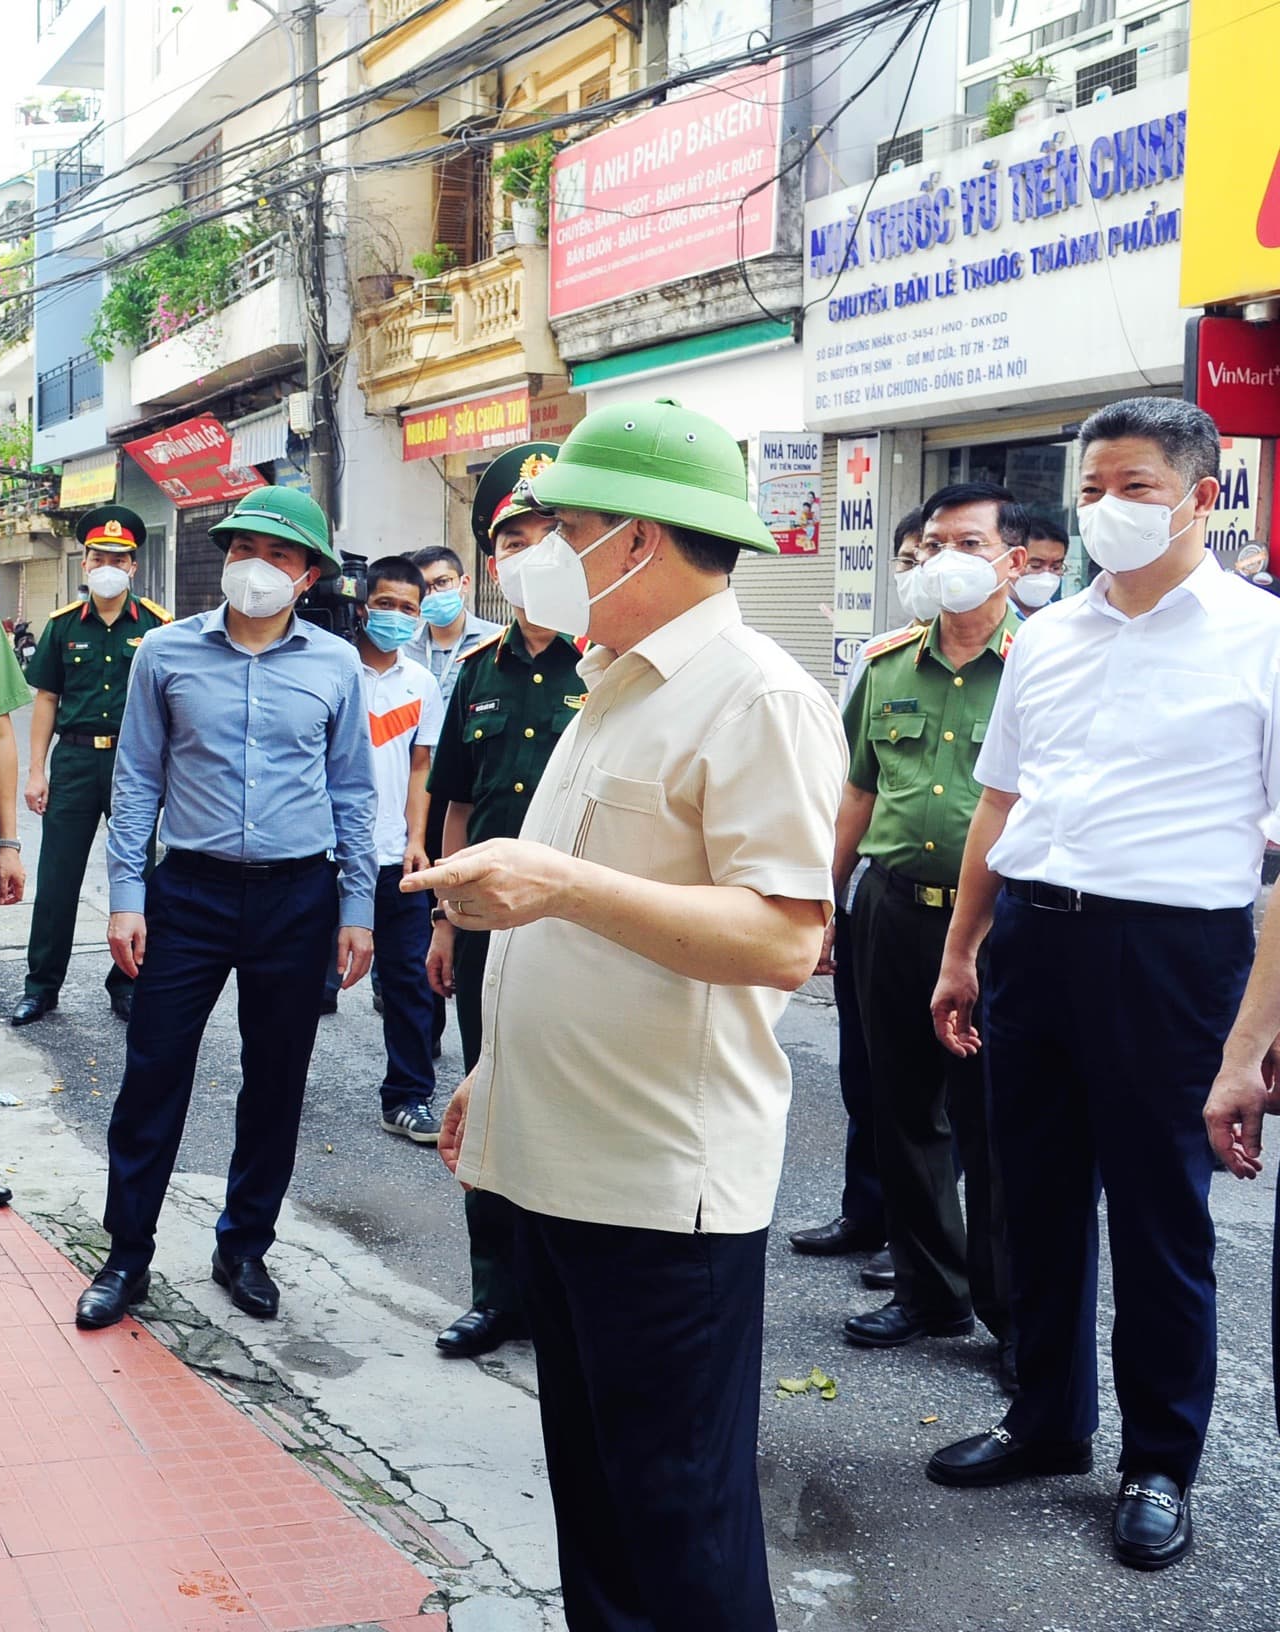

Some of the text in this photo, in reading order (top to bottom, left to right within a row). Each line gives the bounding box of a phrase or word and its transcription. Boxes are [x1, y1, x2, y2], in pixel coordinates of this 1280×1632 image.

[591, 89, 767, 195] ANH PHÁP BAKERY
[808, 205, 864, 280] NHÀ
[866, 172, 956, 264] THUỐC
[1008, 131, 1083, 223] TIẾN
[894, 271, 930, 309] BÁN
[962, 248, 1025, 292] THUỐC
[1030, 231, 1103, 277] THÀNH
[1108, 200, 1181, 259] PHẨM
[764, 437, 818, 460] NHÀ THUỐC
[841, 491, 873, 531] NHÀ
[839, 535, 873, 571] THUỐC
